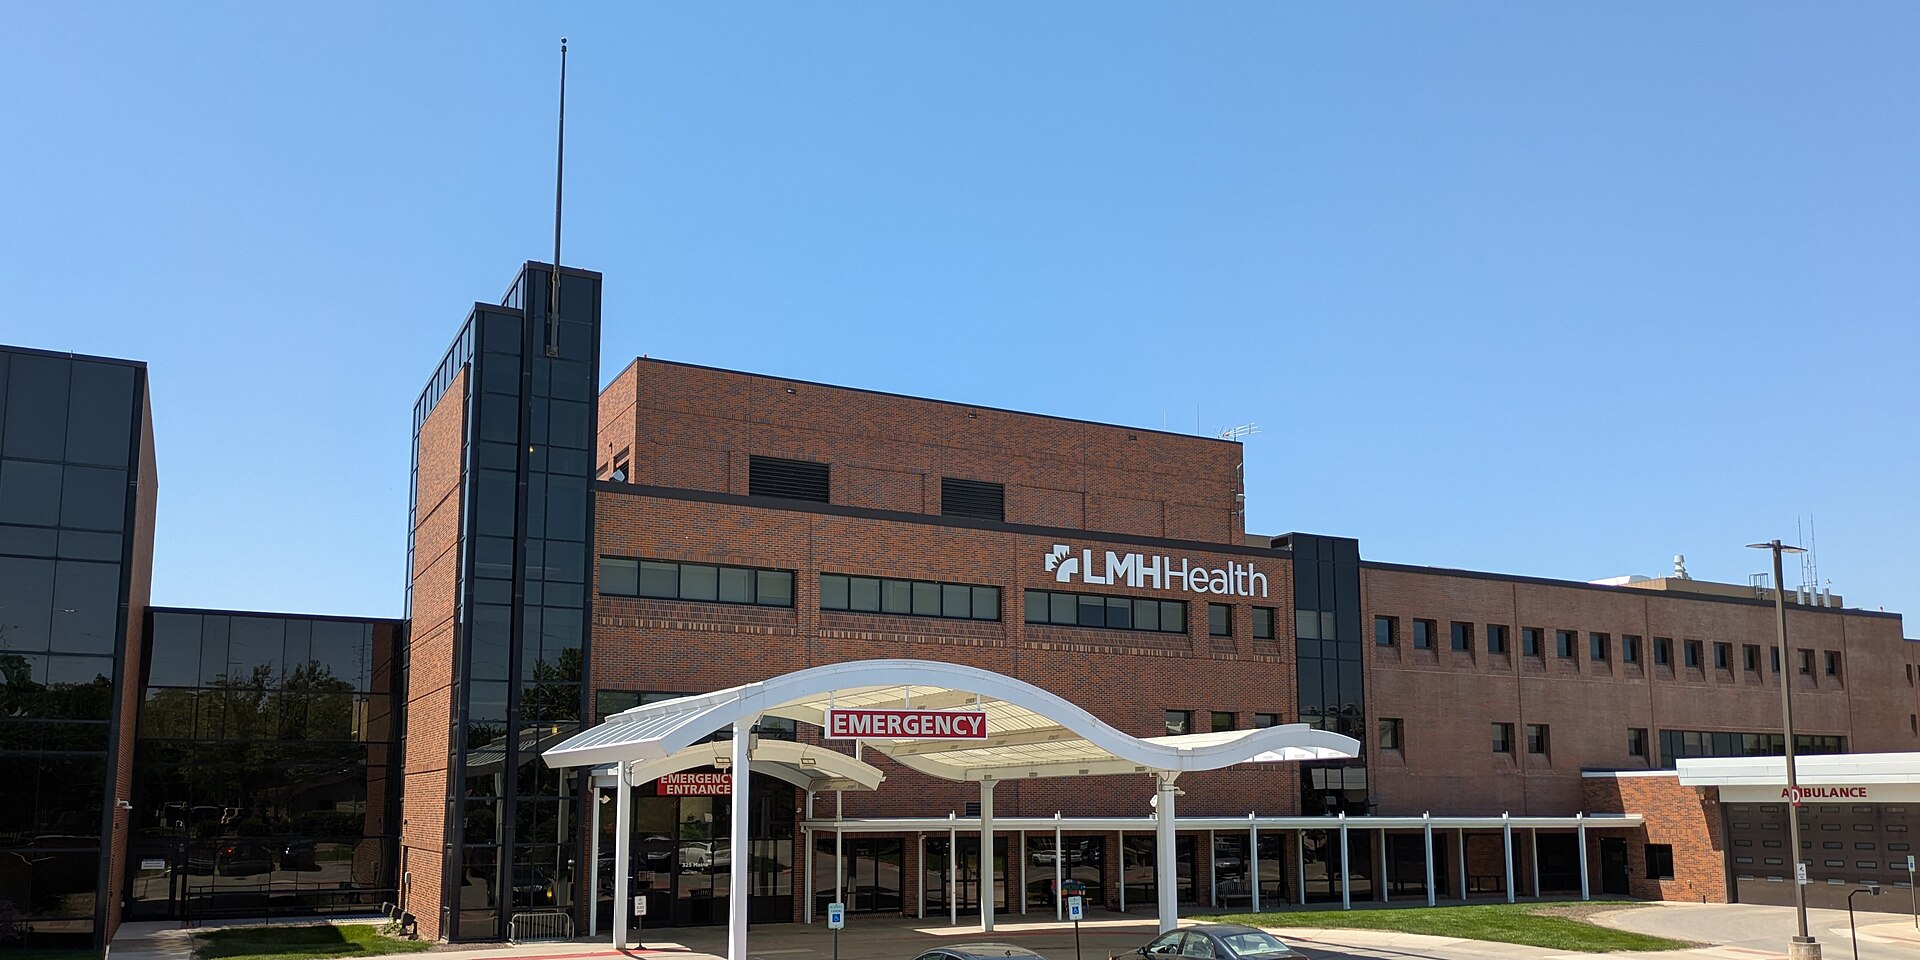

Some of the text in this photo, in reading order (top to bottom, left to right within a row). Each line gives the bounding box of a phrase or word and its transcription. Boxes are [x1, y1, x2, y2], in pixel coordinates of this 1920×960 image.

[833, 714, 983, 735] EMERGENCY
[660, 773, 732, 784] EMERGENC
[666, 784, 731, 795] ENTRANCE
[1781, 787, 1867, 798] ABULANCE
[1791, 788, 1800, 804] D
